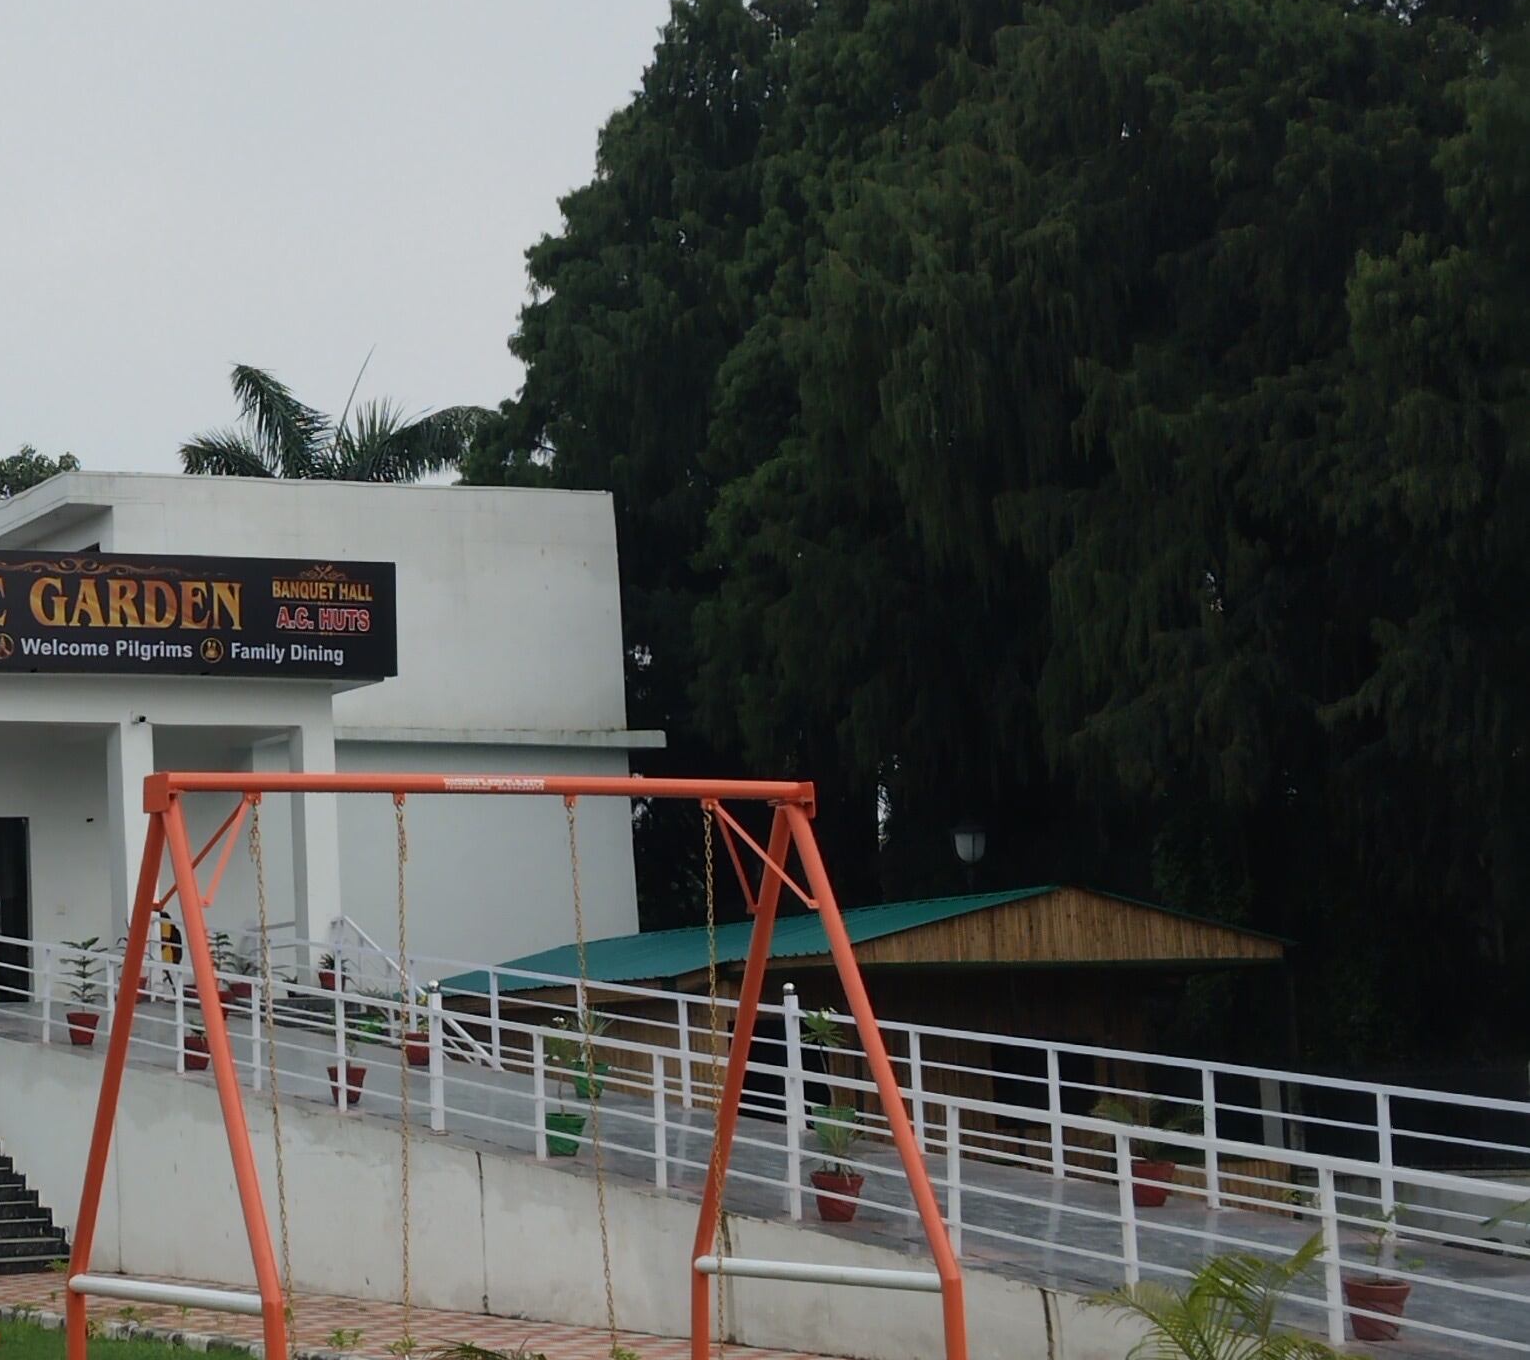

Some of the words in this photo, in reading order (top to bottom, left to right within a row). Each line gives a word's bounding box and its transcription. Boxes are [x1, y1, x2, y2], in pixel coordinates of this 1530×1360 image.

[29, 577, 243, 630] GARDEN
[272, 581, 337, 601] BANQUET
[339, 583, 373, 602] HALL
[276, 606, 315, 630] A.C.
[318, 608, 370, 632] HUTS
[21, 638, 109, 658] Welcome
[115, 640, 193, 661] Pilgrims
[231, 642, 285, 664] Family
[290, 643, 344, 666] Dining
